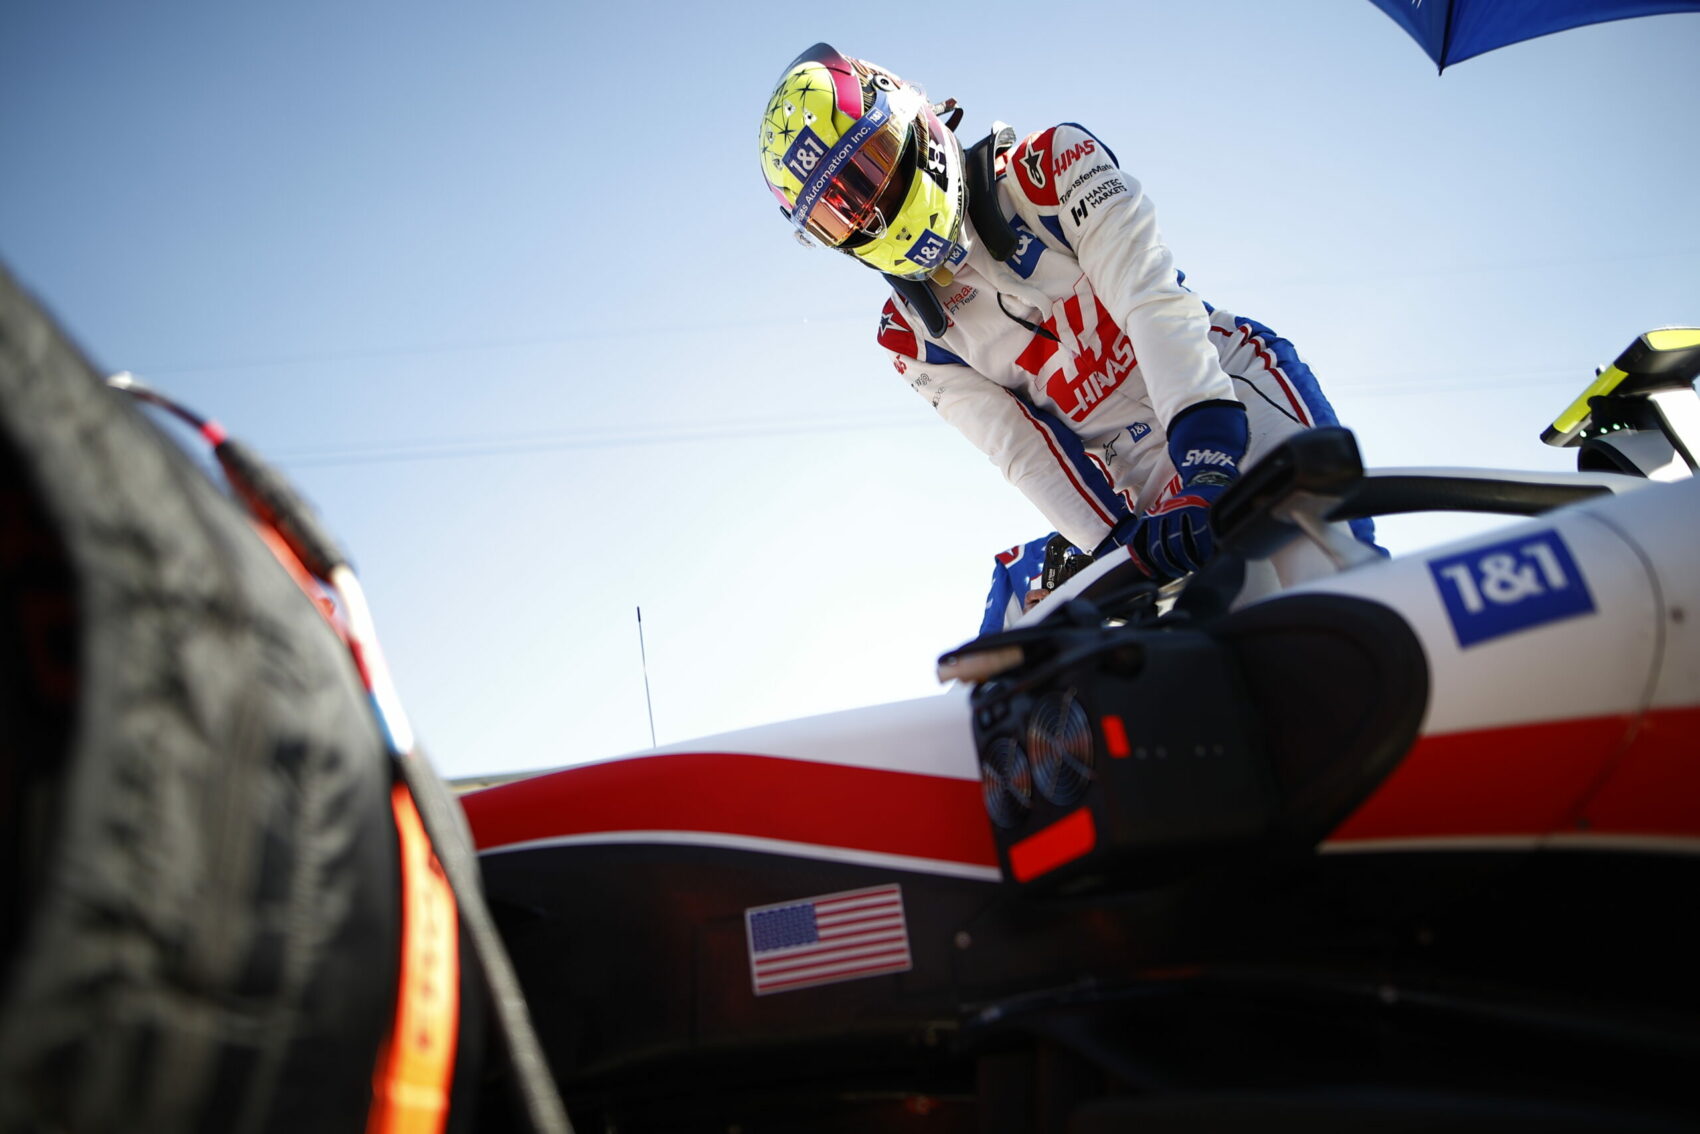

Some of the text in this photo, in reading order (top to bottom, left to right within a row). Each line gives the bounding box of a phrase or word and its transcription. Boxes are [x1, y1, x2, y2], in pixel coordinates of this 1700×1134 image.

[789, 137, 824, 178] 1&1
[805, 143, 853, 205] Automation
[851, 126, 871, 144] Inc.
[1053, 139, 1095, 176] HAAS
[1085, 178, 1122, 202] HANTEC
[1090, 185, 1128, 208] MARKETS
[913, 237, 943, 264] 1&1
[1066, 330, 1135, 416] HAAS
[1130, 423, 1148, 437] 1&1
[1181, 449, 1236, 467] HAAS
[1440, 541, 1569, 614] 1&1
